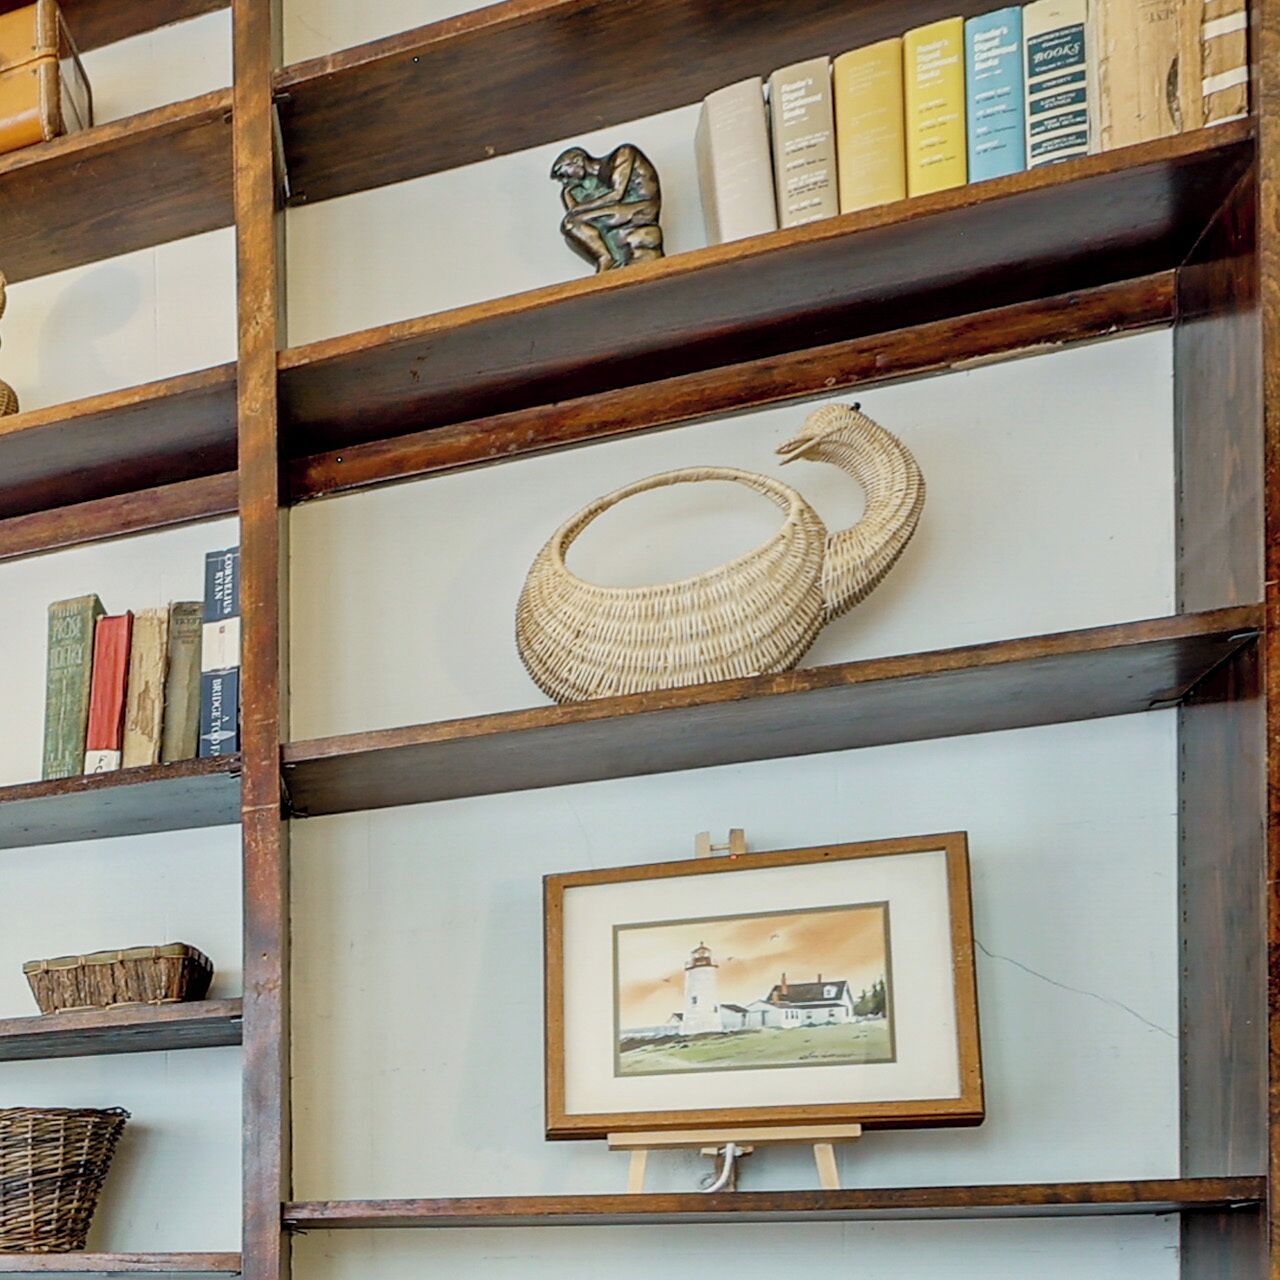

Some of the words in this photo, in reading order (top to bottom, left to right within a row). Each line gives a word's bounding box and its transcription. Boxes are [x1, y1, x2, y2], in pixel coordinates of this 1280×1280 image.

[1033, 42, 1080, 64] BOOKS
[215, 571, 224, 600] RYAN
[223, 553, 233, 615] CORNELIUS
[211, 678, 222, 718] BRIDGE
